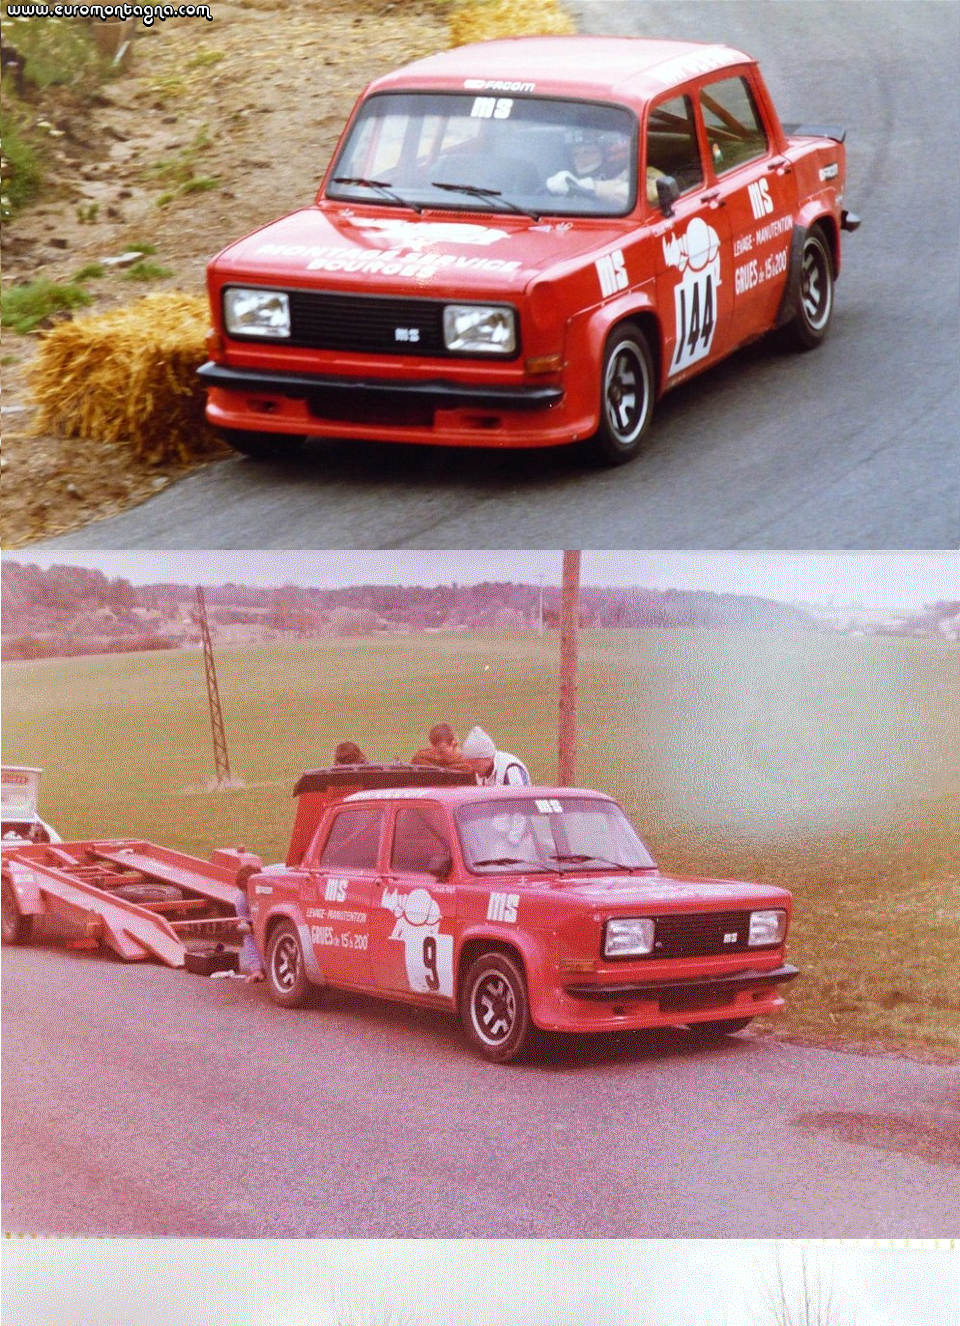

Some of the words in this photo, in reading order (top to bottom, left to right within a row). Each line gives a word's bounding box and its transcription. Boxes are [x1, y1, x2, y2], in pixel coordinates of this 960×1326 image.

[484, 80, 536, 93] FACOM
[733, 233, 753, 257] LEVAGE
[755, 213, 794, 245] MANUTENTION
[256, 244, 398, 262] MONTAGE
[399, 250, 523, 273] SERVICE
[306, 257, 439, 279] BOURGES
[735, 258, 758, 295] GRUES
[674, 273, 714, 365] 144
[422, 936, 440, 992] 9
